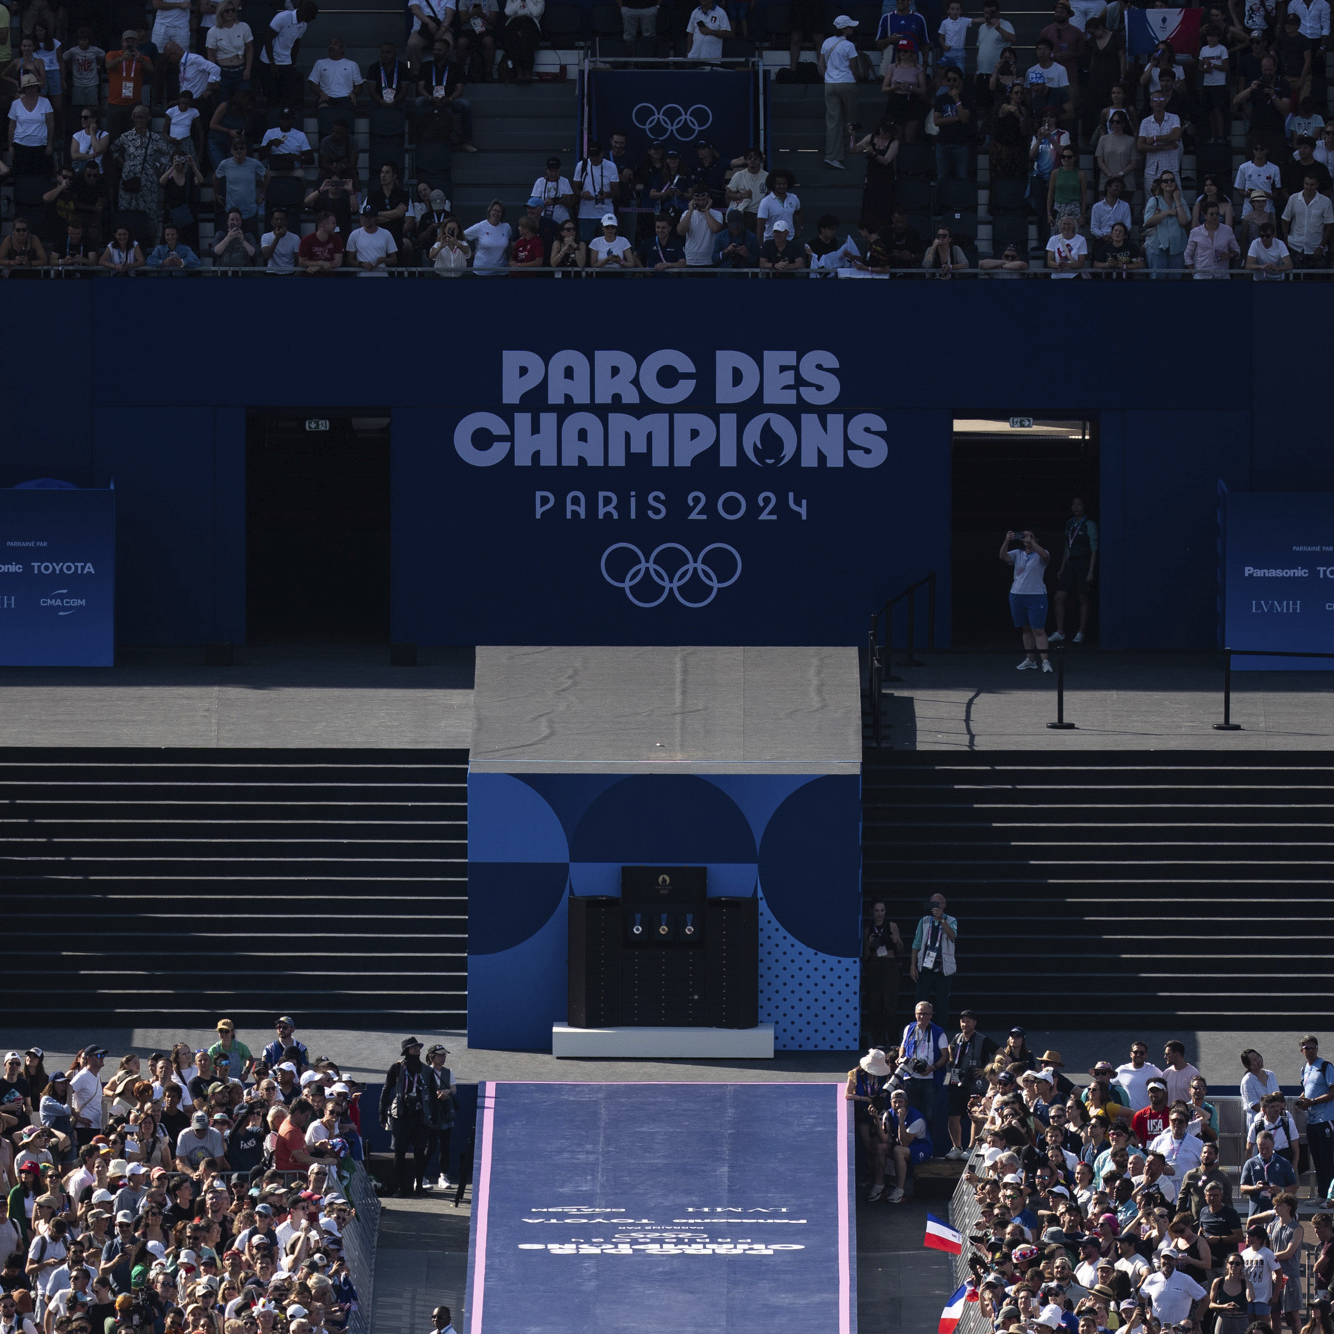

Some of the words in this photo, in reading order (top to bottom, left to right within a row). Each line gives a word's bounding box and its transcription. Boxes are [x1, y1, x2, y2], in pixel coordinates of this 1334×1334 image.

[502, 348, 697, 405] PARC
[715, 349, 841, 406] DES
[453, 411, 888, 468] CHAMPIONS
[687, 490, 808, 521] 2024
[30, 562, 95, 575] TOYOTA
[1244, 566, 1309, 577] Panasonic
[40, 598, 63, 606] CMA
[63, 598, 86, 607] CGM
[1252, 600, 1301, 613] LVMH
[1147, 1119, 1163, 1131] USA
